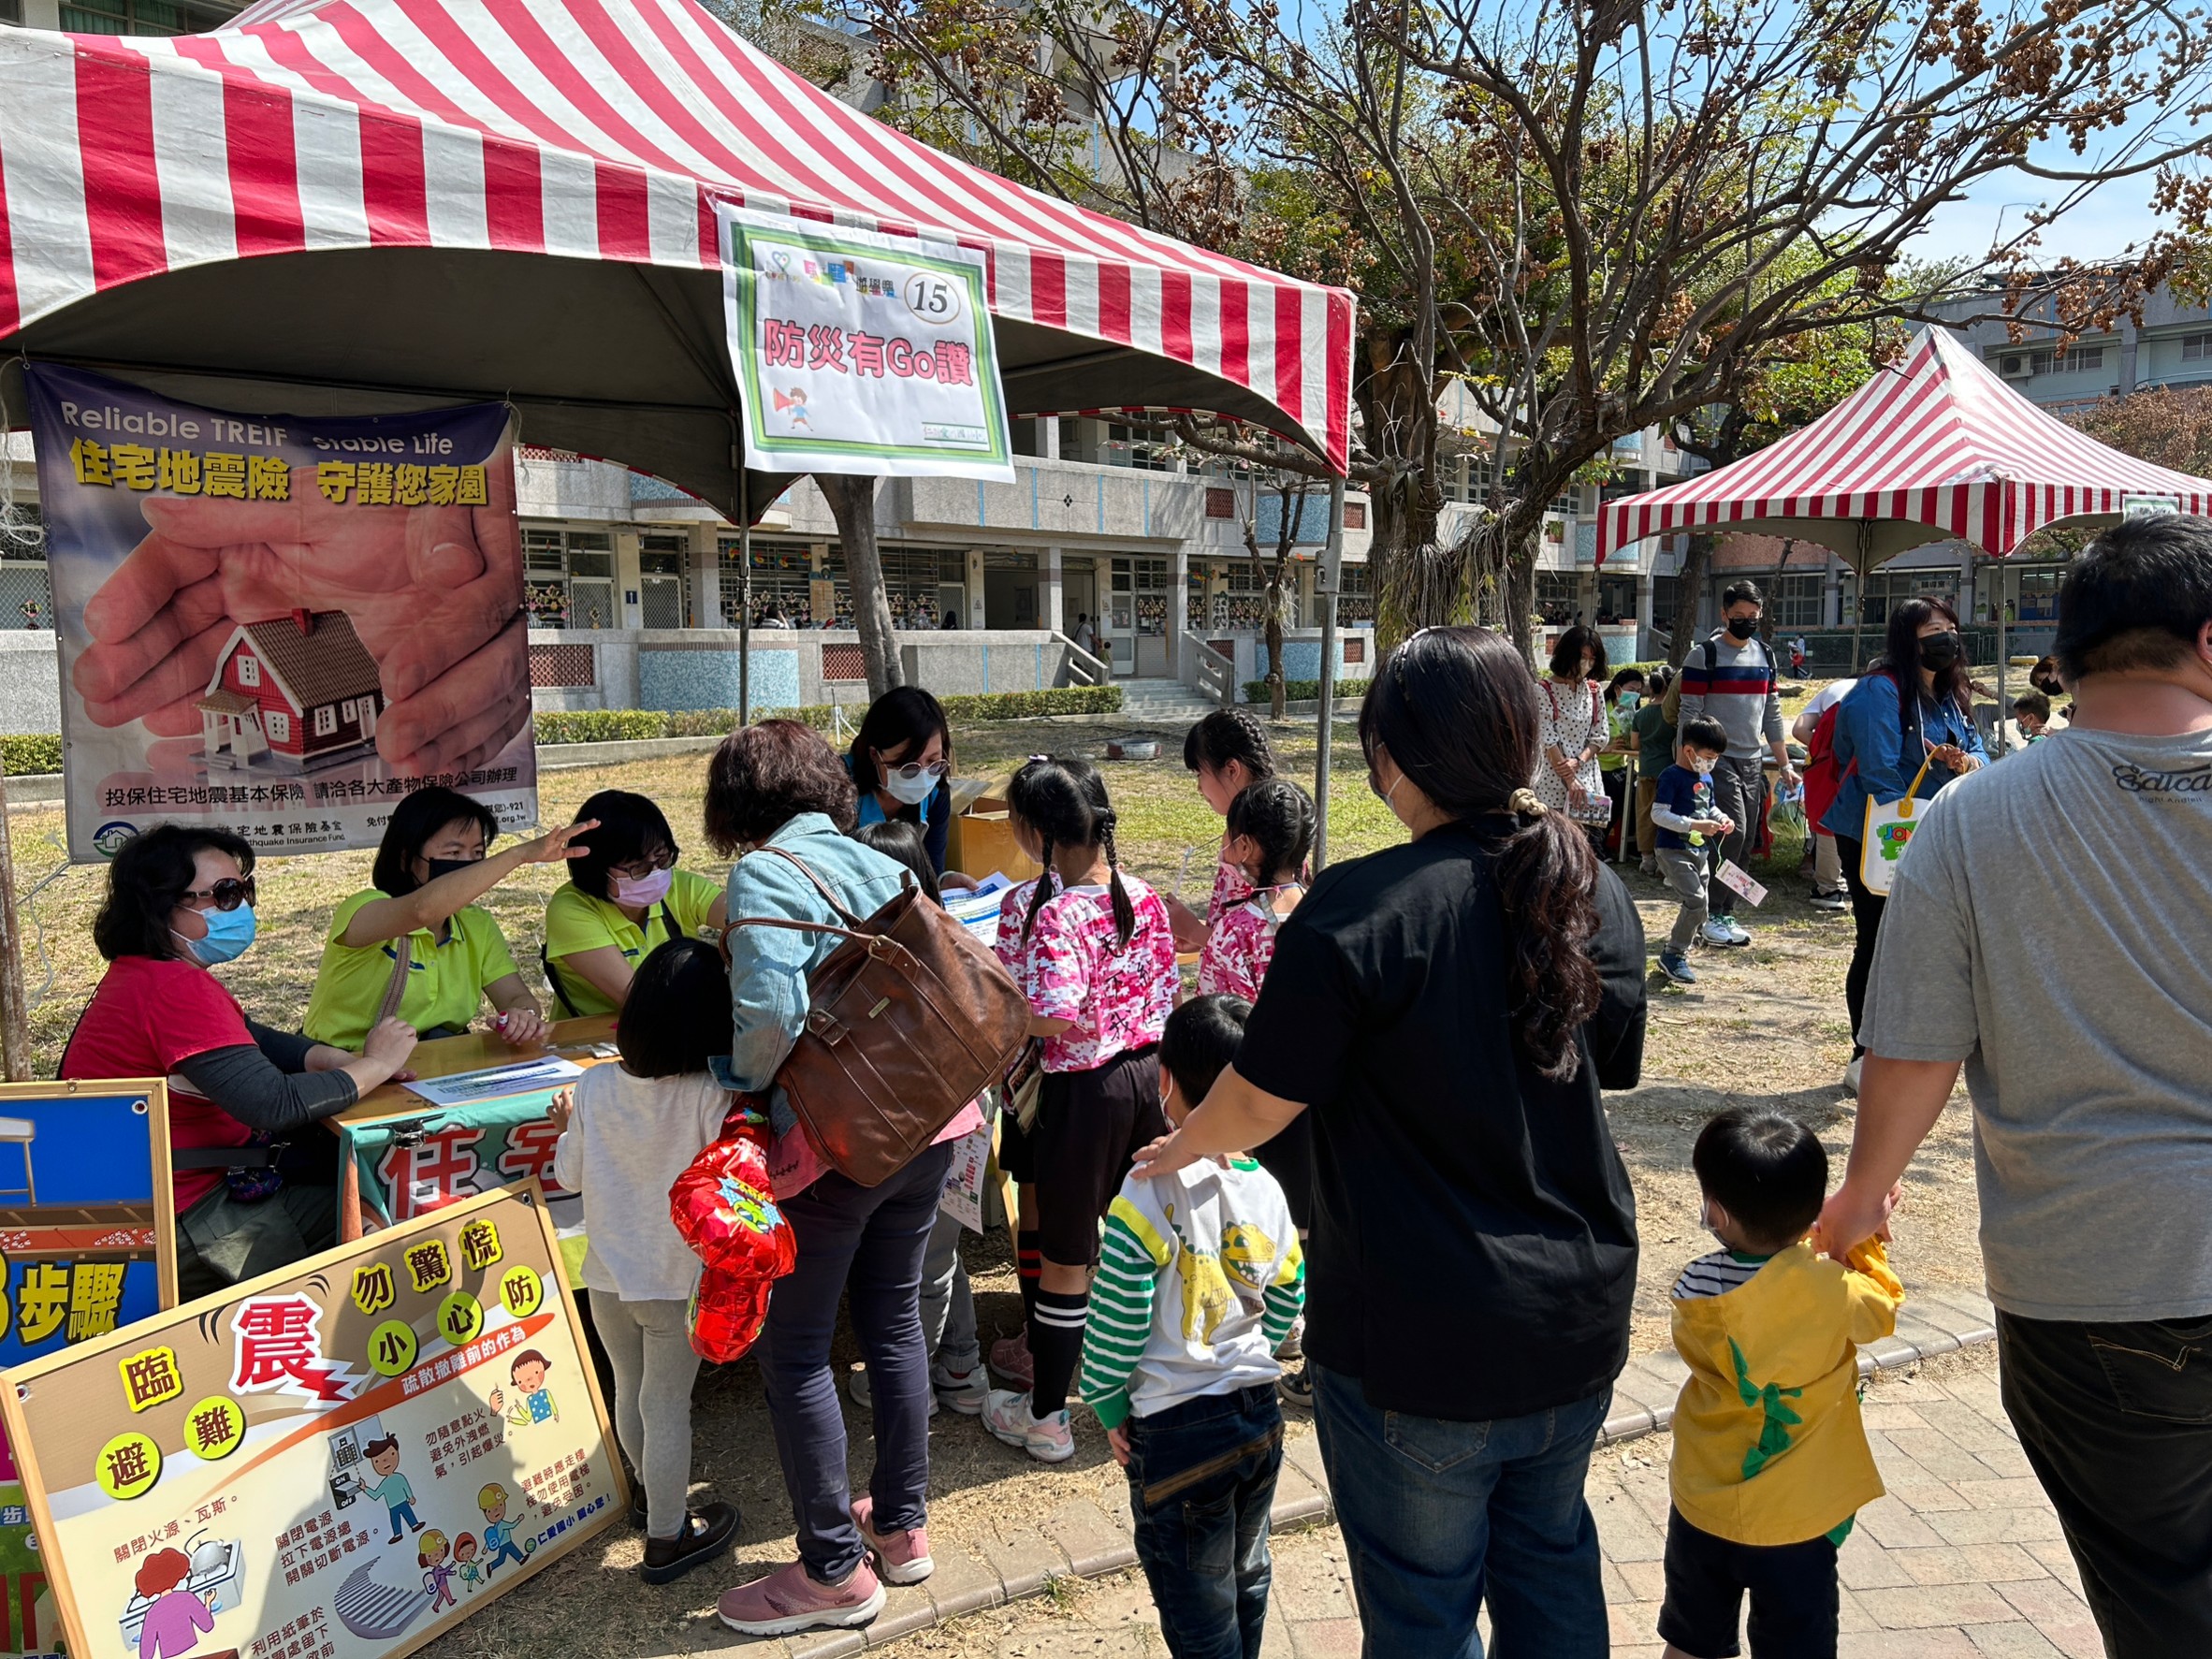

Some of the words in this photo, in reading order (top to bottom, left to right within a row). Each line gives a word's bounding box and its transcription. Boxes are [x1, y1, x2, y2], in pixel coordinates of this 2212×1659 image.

[913, 281, 948, 313] 15
[764, 318, 973, 386] 防災有Go讚
[61, 401, 199, 439] Reliable
[211, 418, 288, 446] TREIF
[412, 432, 453, 455] Life
[68, 436, 290, 501] 住宅地震險
[316, 459, 488, 505] 守護您家園
[106, 782, 307, 808] 投保住宅地震基本保險
[313, 766, 517, 800] 請洽各大產物保險公司辦理
[249, 837, 284, 848] thquake
[286, 834, 327, 846] Insurance
[328, 833, 345, 842] Fund
[0, 1249, 124, 1343] 步驟
[401, 1325, 526, 1396] 疏散撤離前的作為
[425, 1407, 486, 1447] 勿隨意點火
[429, 1422, 490, 1463] 避免外洩燃
[335, 1476, 346, 1485] ON
[520, 1448, 587, 1494] 避難時應走樓
[525, 1463, 590, 1508] 梯勿使用電梯
[3, 1505, 30, 1524] 步
[113, 1495, 238, 1564] 關閉火源、瓦斯。
[275, 1509, 333, 1551] 關閉電源
[280, 1521, 352, 1568] 拉下電源總
[284, 1527, 379, 1586] 開關切斷電源。
[251, 1606, 325, 1656] 利用紙筆於
